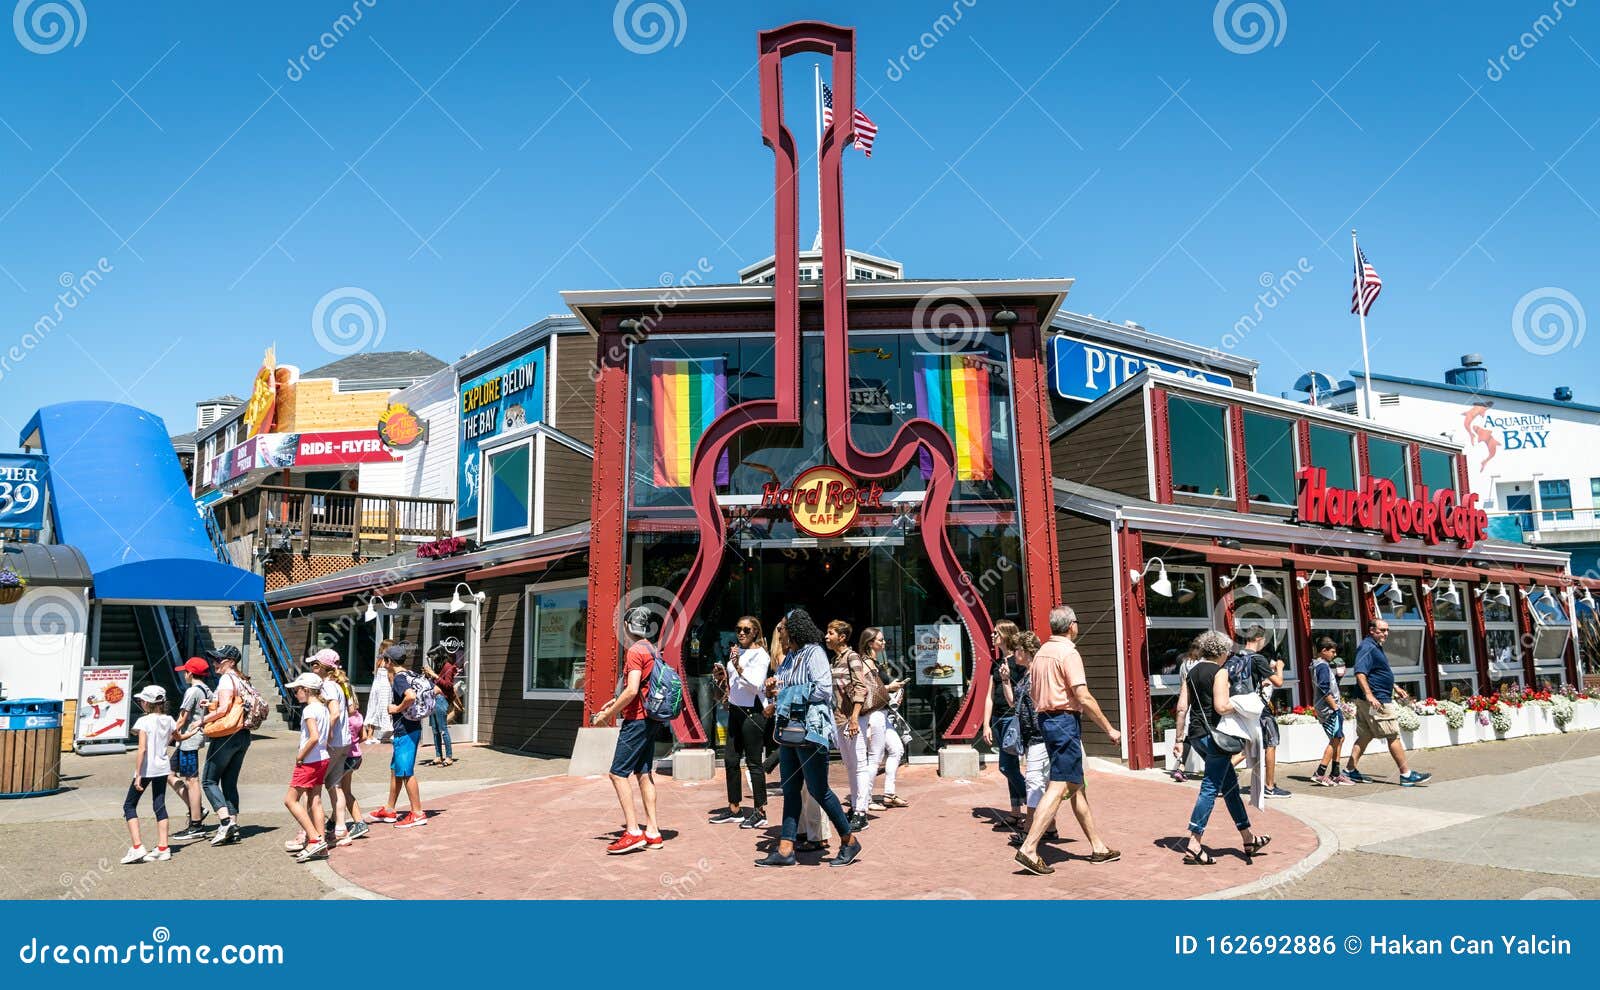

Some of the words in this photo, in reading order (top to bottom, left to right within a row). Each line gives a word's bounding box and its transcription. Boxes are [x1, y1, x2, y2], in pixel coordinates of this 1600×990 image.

[463, 376, 501, 413] EXPLORE
[502, 362, 537, 397] BELOW
[463, 417, 479, 441] THE
[480, 407, 497, 436] BAY
[1484, 414, 1552, 429] AQUARIUM
[301, 441, 333, 456] RIDE
[341, 439, 381, 454] FLYER
[1503, 430, 1550, 450] BAY
[761, 481, 823, 506] Hard
[825, 480, 884, 510] Rock
[809, 514, 840, 525] CAFE
[1297, 466, 1374, 528] Hard
[1370, 479, 1440, 545] Rock
[1434, 489, 1489, 550] Cafe
